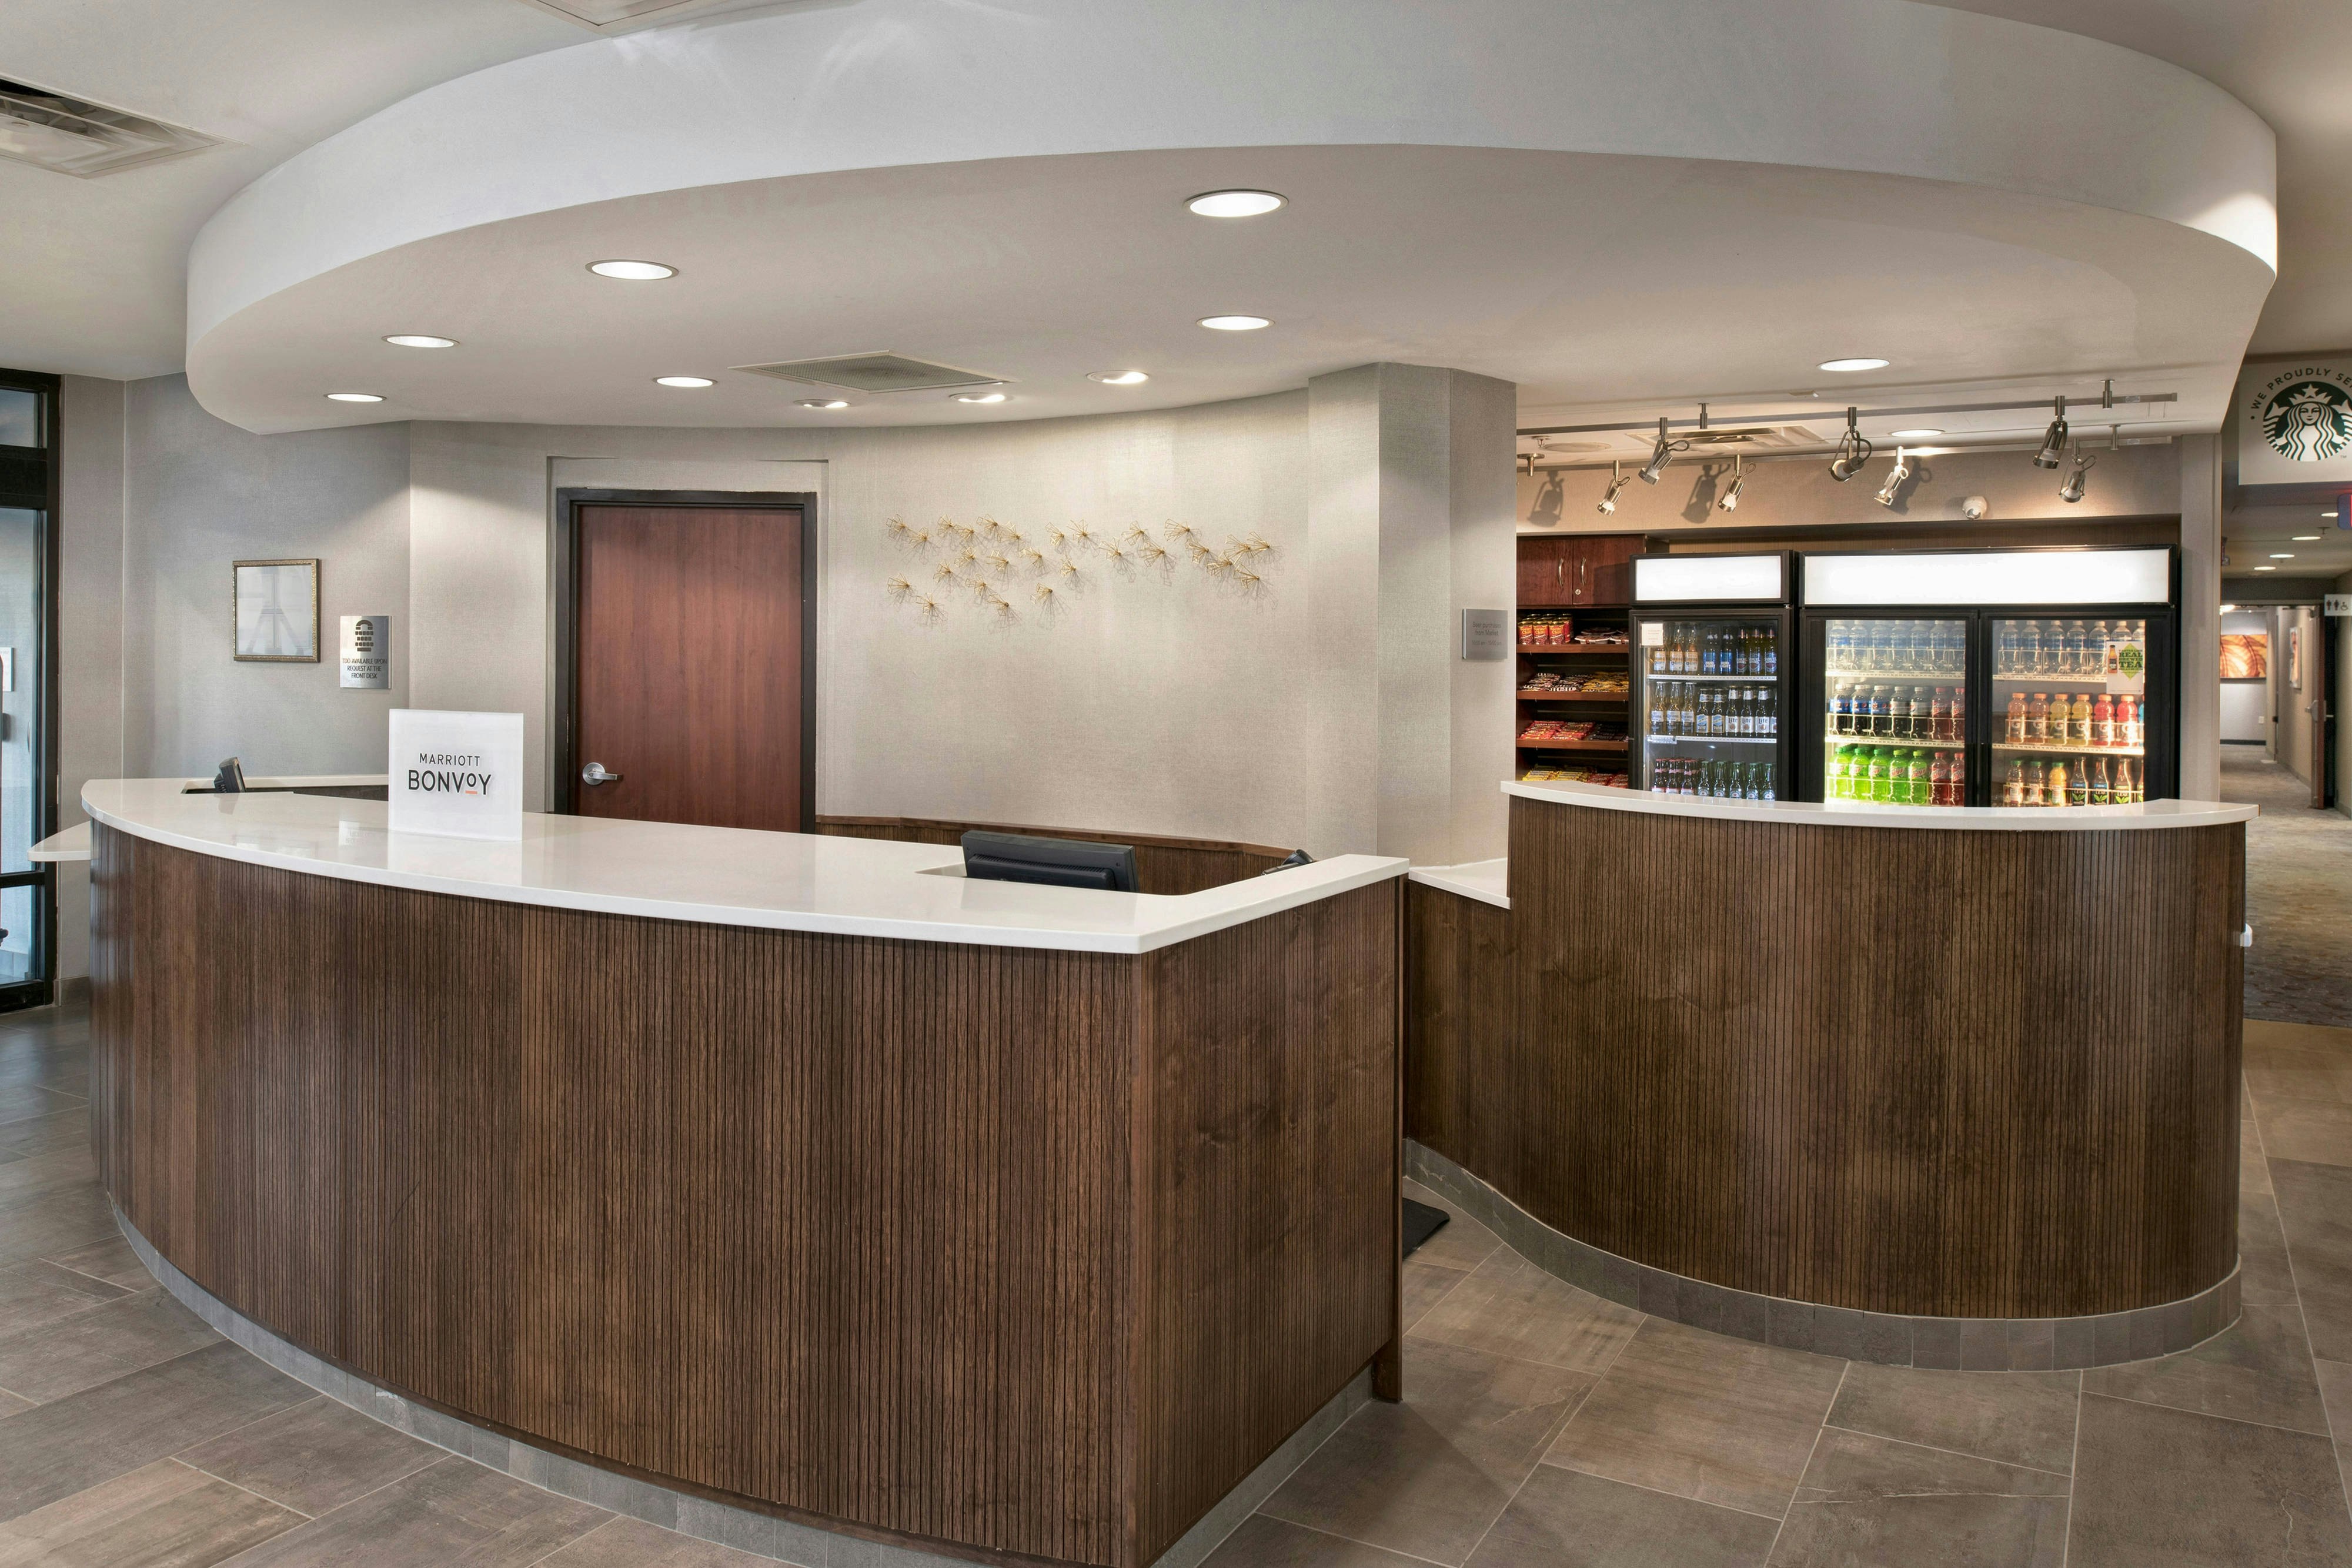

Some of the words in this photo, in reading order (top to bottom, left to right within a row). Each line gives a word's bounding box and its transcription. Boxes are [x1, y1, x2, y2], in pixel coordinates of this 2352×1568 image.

[2251, 392, 2267, 409] WE
[2267, 367, 2331, 390] PROUDLY
[419, 753, 480, 767] MARRIOTT
[408, 770, 491, 795] BONVOY
